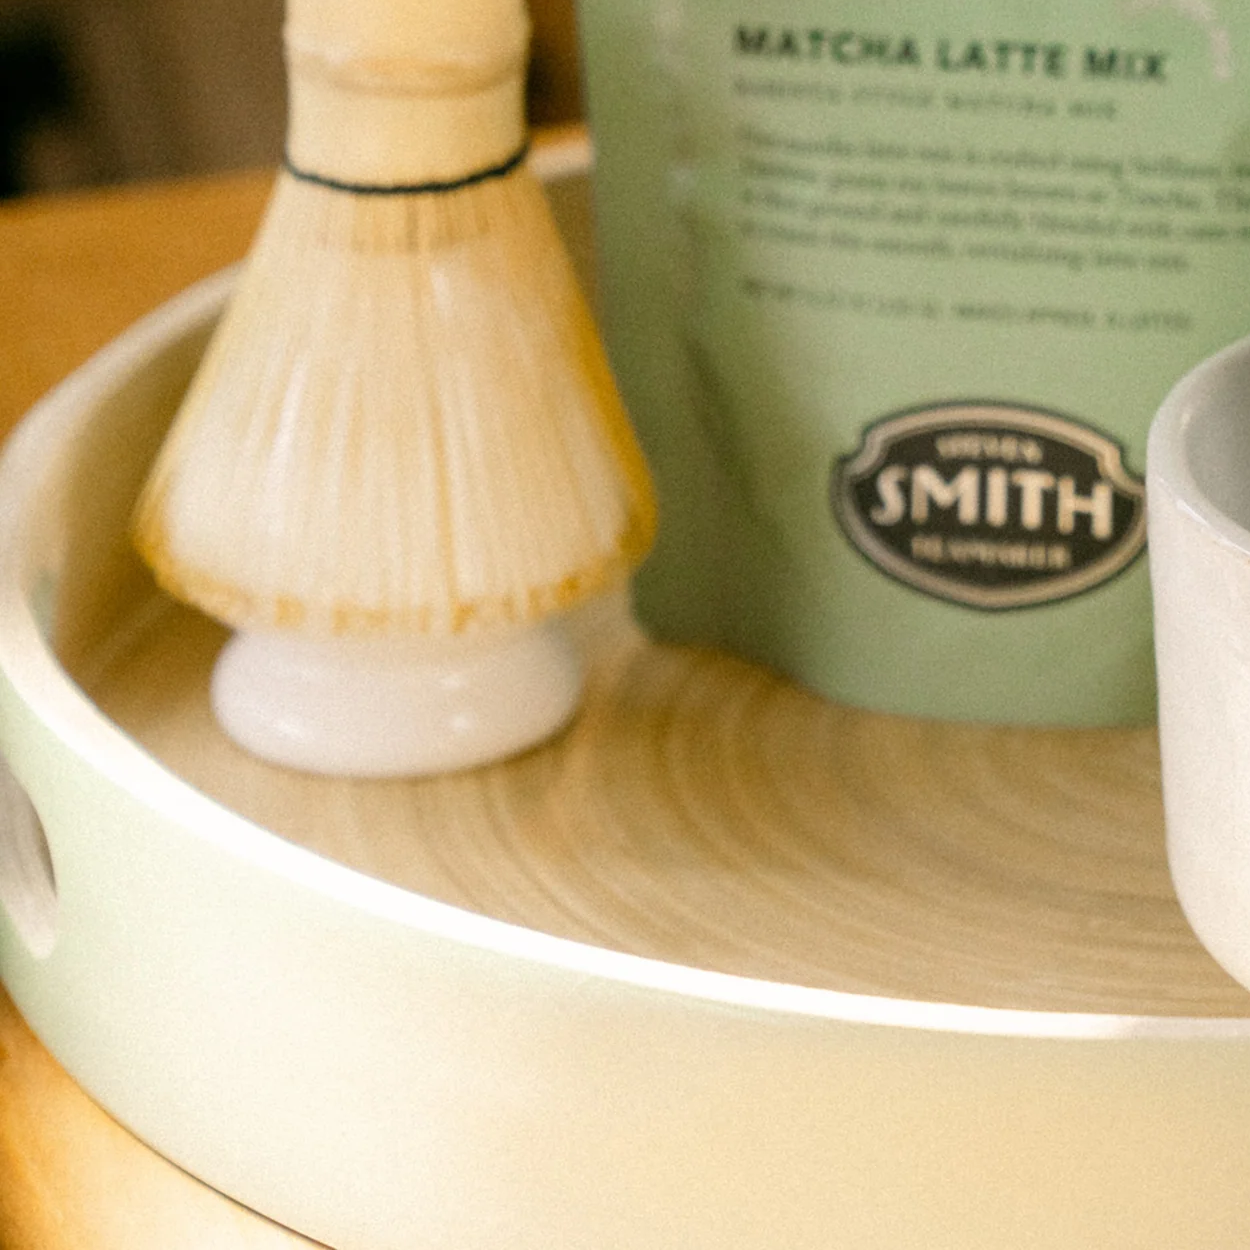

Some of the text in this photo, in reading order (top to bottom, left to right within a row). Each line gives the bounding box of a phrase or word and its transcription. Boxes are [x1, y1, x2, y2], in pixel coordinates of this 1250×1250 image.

[734, 24, 1168, 84] MATCHA LATTE MIX
[869, 463, 1113, 540] SMITH
